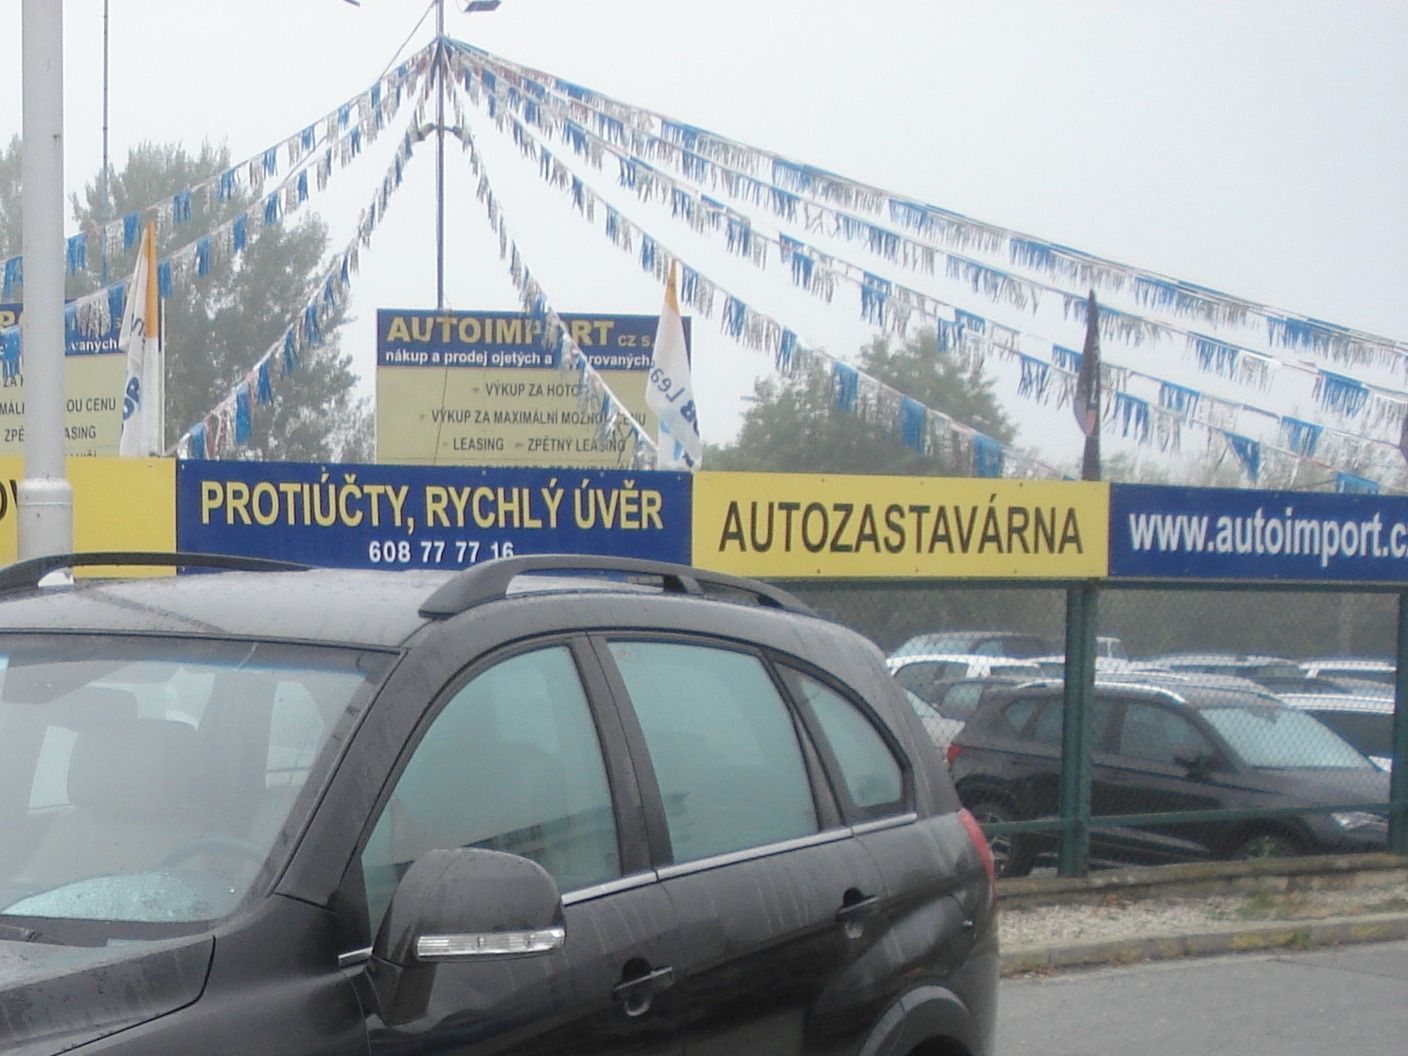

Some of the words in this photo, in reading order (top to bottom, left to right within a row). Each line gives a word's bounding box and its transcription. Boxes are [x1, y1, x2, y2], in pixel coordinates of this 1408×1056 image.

[387, 316, 615, 346] AUTOIMPRT
[385, 348, 428, 364] nákup
[432, 352, 440, 362] a
[444, 350, 488, 366] prodej
[492, 351, 541, 366] ojetých
[545, 355, 553, 364] a
[485, 381, 526, 397] VÝKUP
[529, 383, 543, 397] ZA
[86, 397, 116, 412] CENU
[432, 407, 471, 424] VÝKUP
[475, 410, 490, 424] ZA
[494, 408, 558, 425] MAXIMÁLNÍ
[65, 425, 96, 440] ASING
[453, 436, 504, 451] LEASING
[201, 474, 415, 535] PROTIÚČTY,
[425, 478, 565, 530] RYCHLÝ
[574, 479, 664, 531] ÚVĚR
[718, 494, 1085, 556] AUTOZASTAVÁRNA
[1129, 508, 1408, 568] www.autoimport.c
[369, 541, 412, 564] 608
[420, 542, 446, 564] 77
[455, 542, 479, 564] 77
[491, 542, 514, 560] 16
